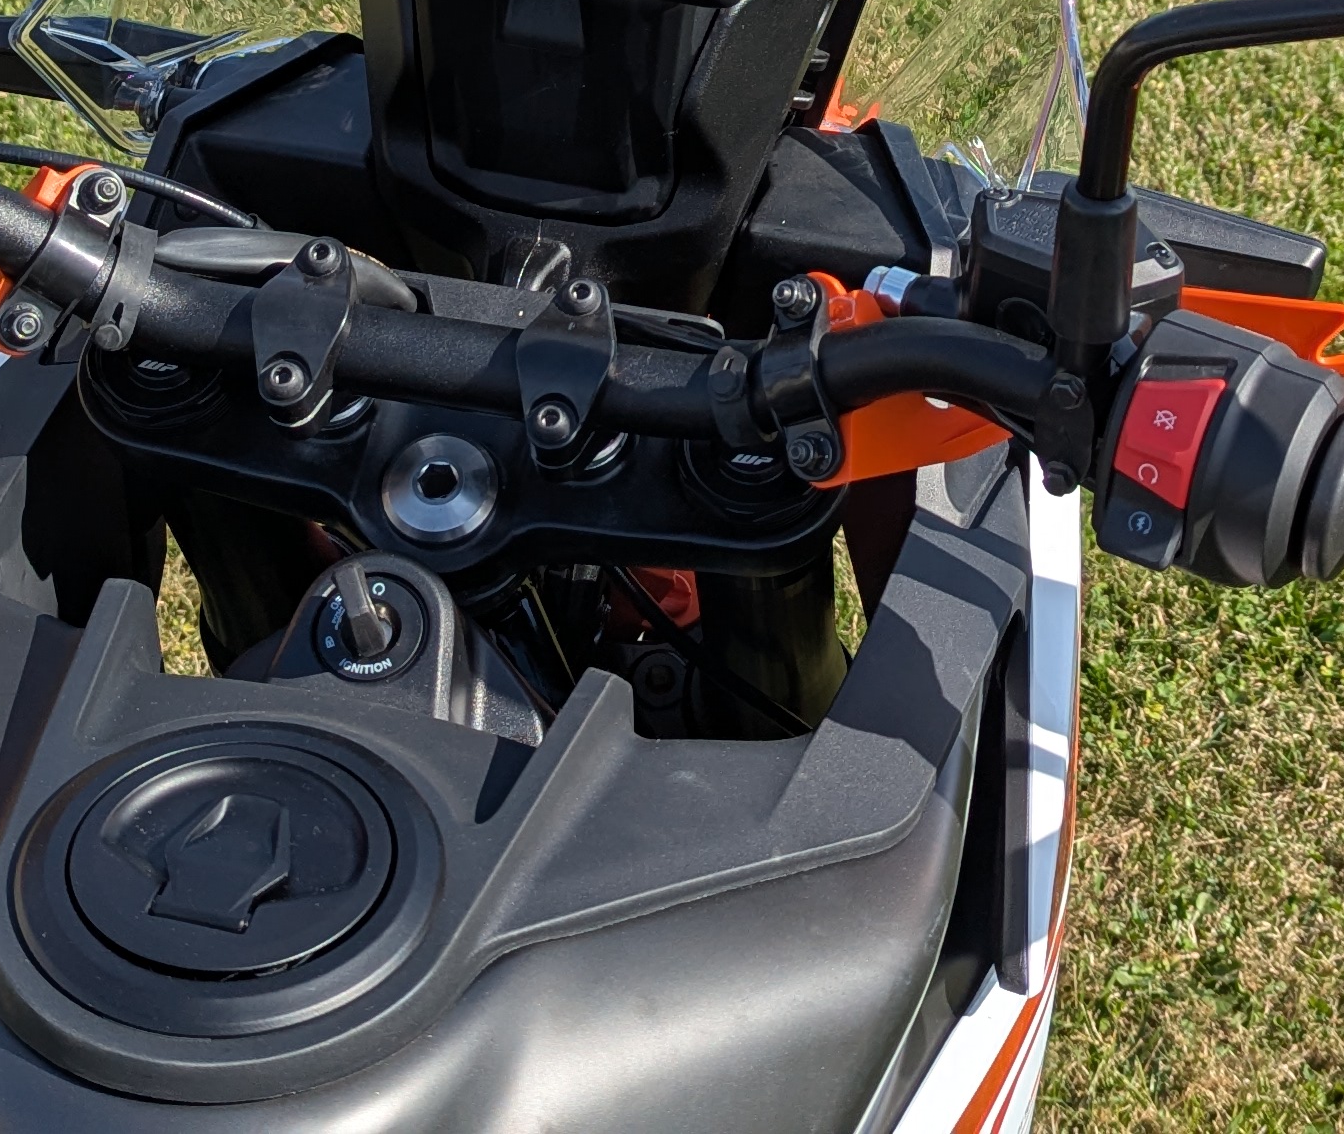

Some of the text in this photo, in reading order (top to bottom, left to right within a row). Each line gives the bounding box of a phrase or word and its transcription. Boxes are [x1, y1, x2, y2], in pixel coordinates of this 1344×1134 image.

[137, 359, 179, 372] WP
[730, 453, 774, 466] WP
[338, 658, 393, 674] IGNITION
